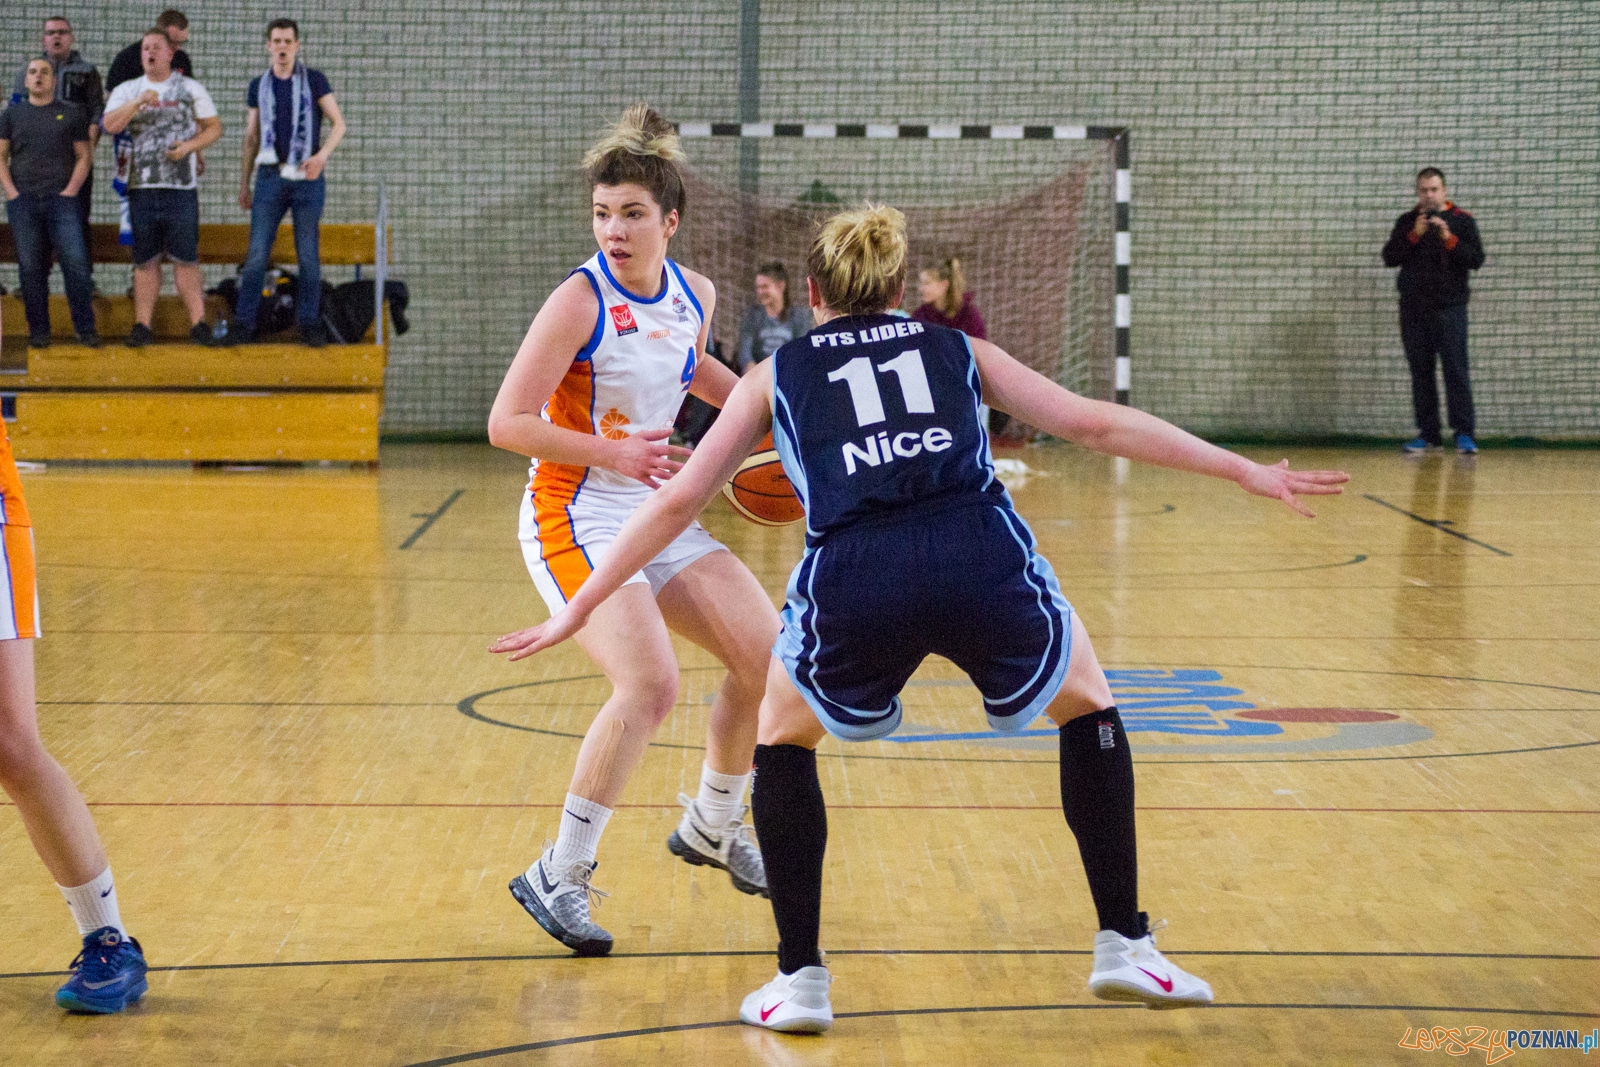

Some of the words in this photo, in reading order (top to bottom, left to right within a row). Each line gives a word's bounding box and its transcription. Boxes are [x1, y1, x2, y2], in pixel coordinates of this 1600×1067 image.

[810, 332, 856, 348] PTS
[859, 321, 925, 344] LIDER
[680, 346, 697, 393] 4
[827, 349, 936, 428] 11
[842, 427, 953, 476] Nice
